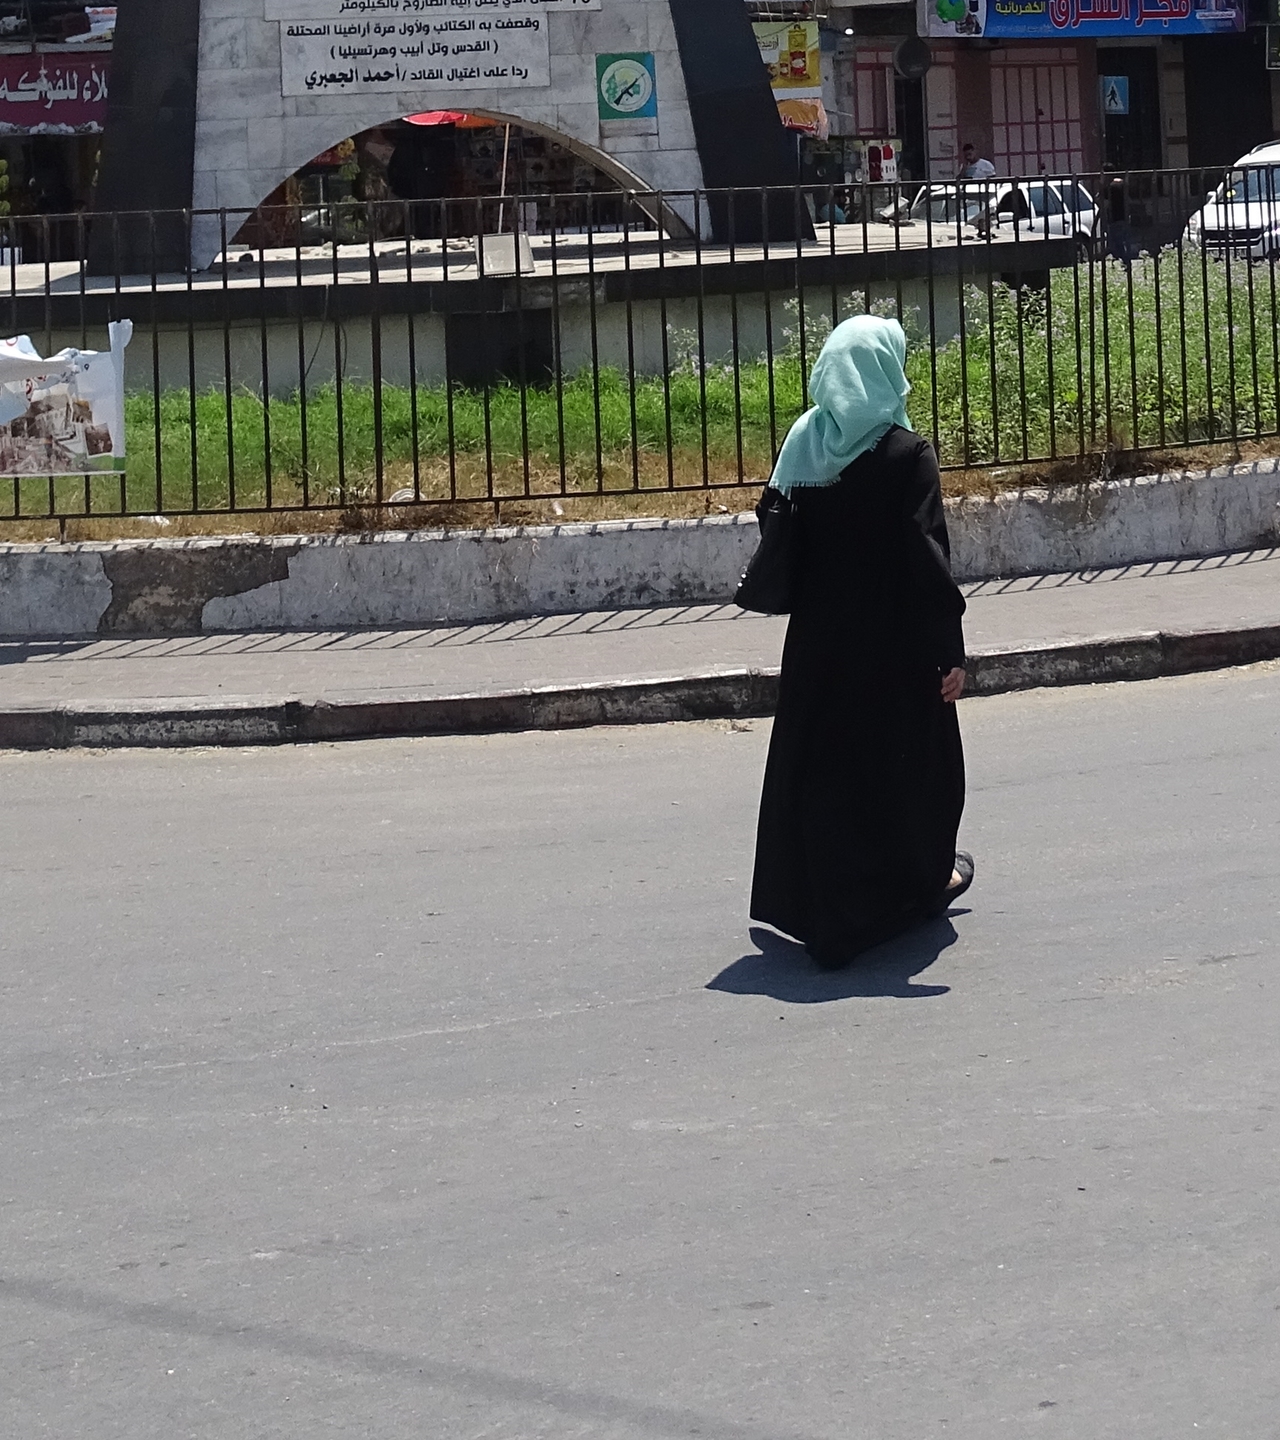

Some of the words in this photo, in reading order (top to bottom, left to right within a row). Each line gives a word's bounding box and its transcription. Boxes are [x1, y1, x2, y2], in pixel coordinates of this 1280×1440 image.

[994, 0, 1046, 16] الكهربائية
[286, 24, 330, 37] المحتلة
[334, 21, 370, 38] أراضينا
[373, 23, 396, 37] مرة
[399, 19, 430, 36] ولأول
[433, 20, 475, 34] الكتائب
[478, 20, 492, 33] به
[495, 17, 540, 31] وقصفت
[338, 45, 397, 59] وهرتسيليا
[400, 41, 424, 56] أبيب
[427, 43, 448, 56] وتل
[452, 40, 490, 55] القدس
[362, 63, 400, 83] أحمد
[410, 68, 443, 81] القائد
[446, 67, 480, 82] اغتيال
[483, 66, 508, 77] على
[511, 65, 528, 79] ردا
[304, 68, 358, 90] الجعبري
